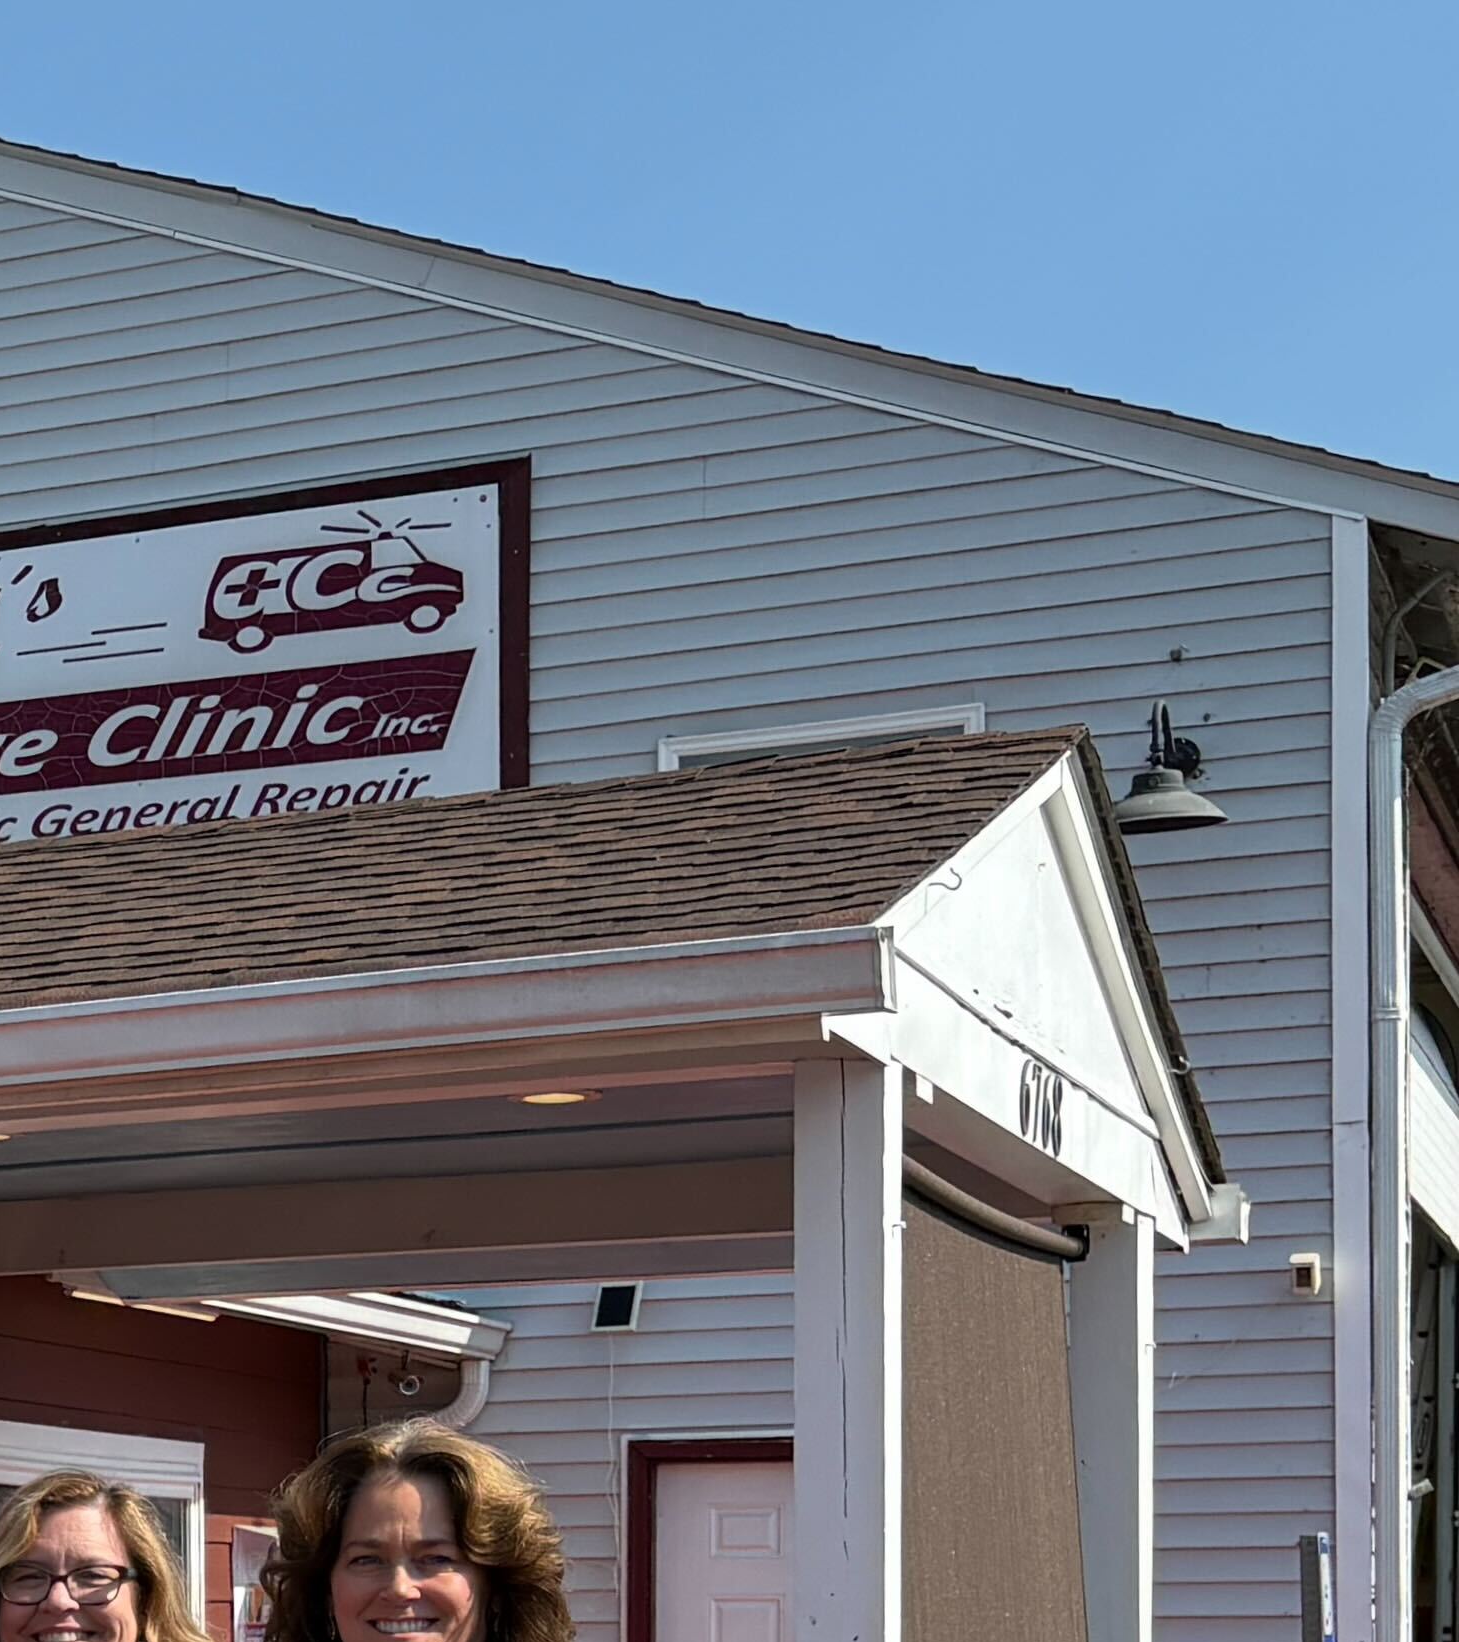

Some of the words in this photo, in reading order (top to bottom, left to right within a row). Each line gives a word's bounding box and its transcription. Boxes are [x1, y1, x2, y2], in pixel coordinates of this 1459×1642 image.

[87, 683, 365, 768] Clinic
[30, 784, 243, 838] General
[250, 767, 431, 816] Repair
[1019, 1058, 1063, 1158] 6768
